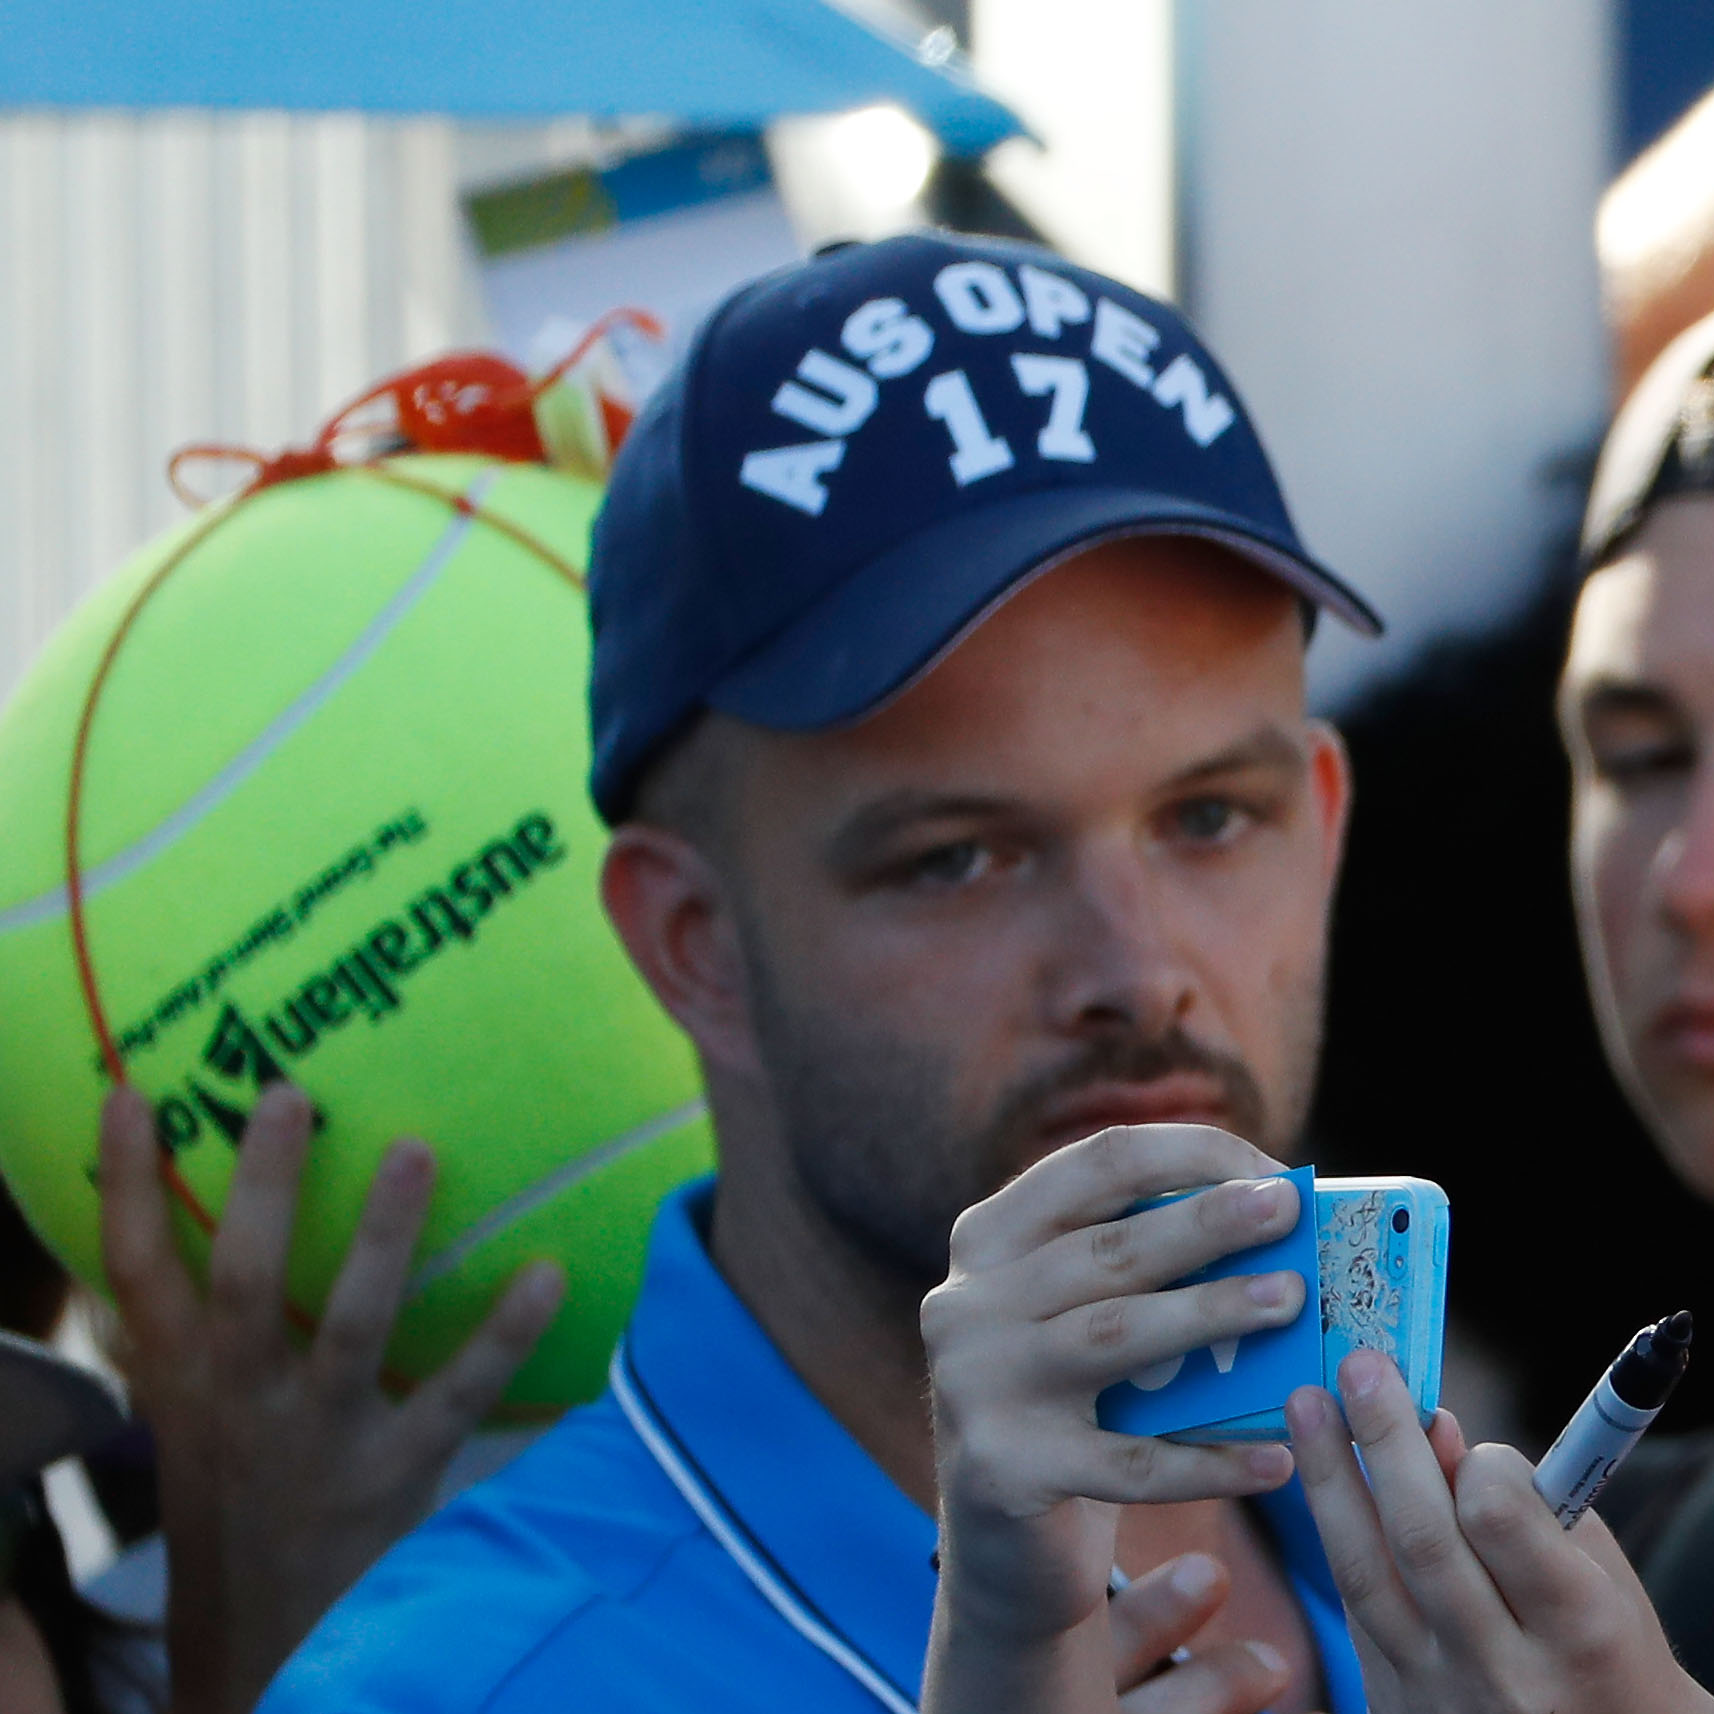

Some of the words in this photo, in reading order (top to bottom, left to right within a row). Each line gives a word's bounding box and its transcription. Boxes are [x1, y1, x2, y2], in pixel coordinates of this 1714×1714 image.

[739, 297, 935, 519] AUS
[932, 261, 1236, 448] OPEN
[923, 352, 1097, 488] 17
[264, 812, 568, 1056] australian
